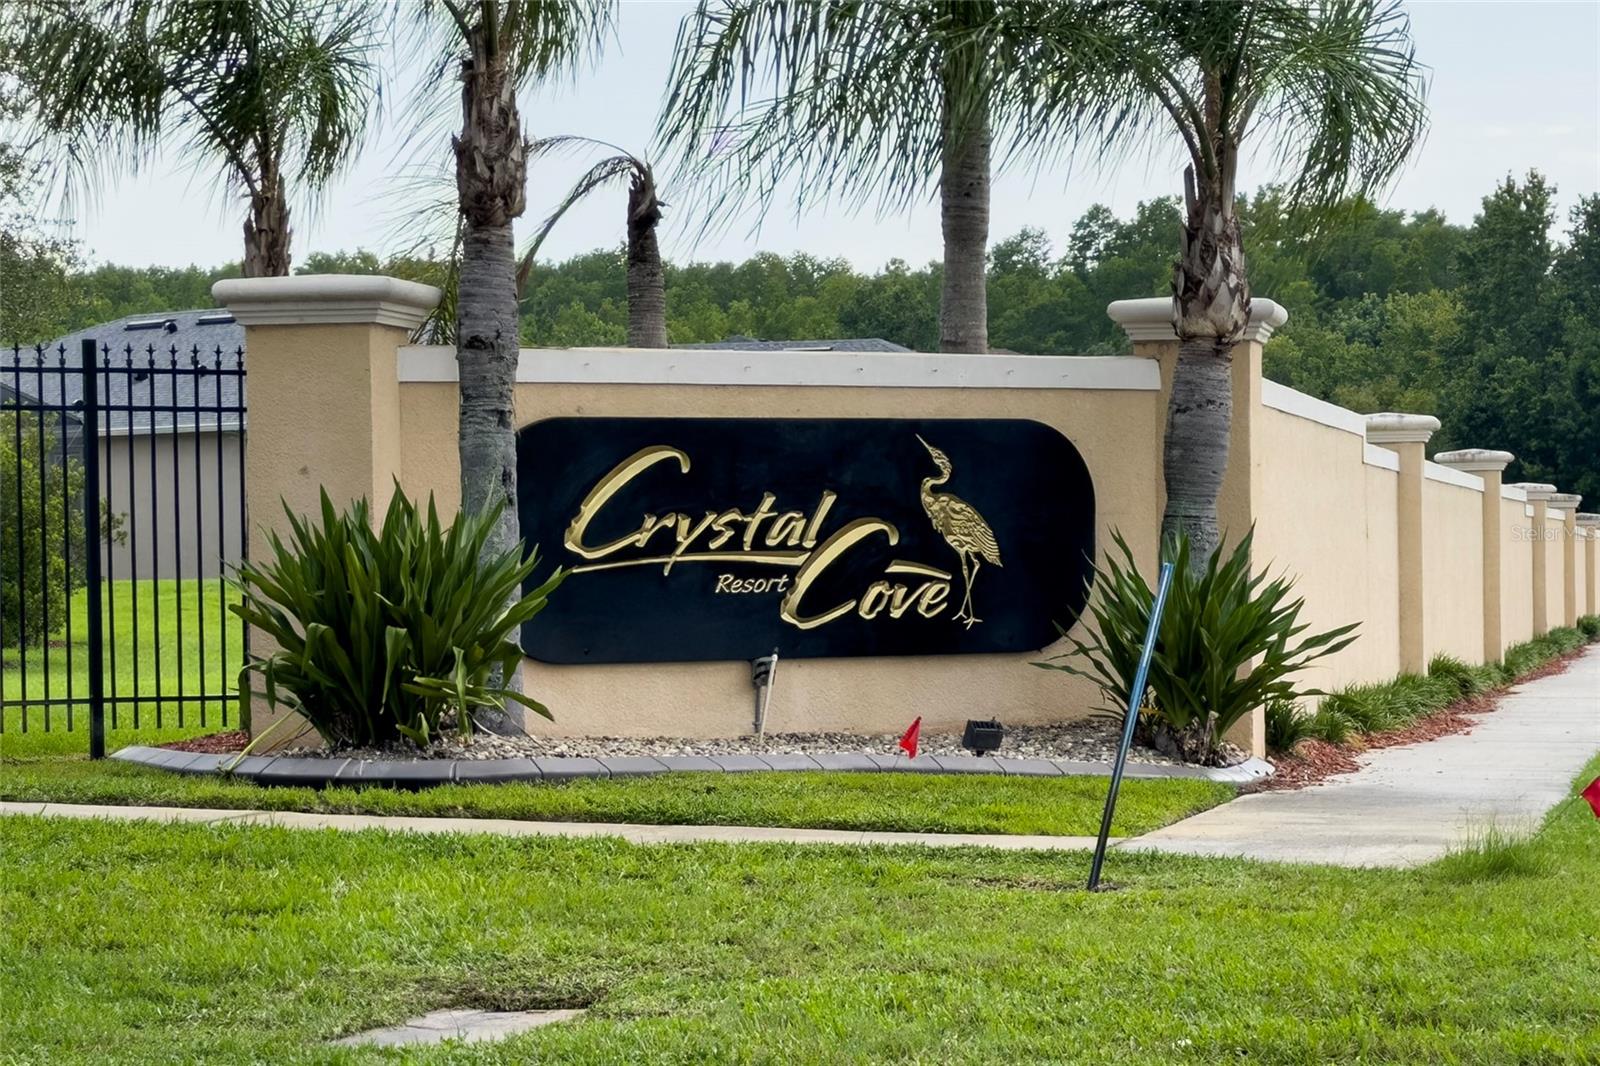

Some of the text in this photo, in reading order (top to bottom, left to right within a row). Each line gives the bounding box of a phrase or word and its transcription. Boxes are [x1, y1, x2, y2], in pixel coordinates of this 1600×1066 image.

[564, 445, 837, 576] Crystal
[715, 573, 789, 594] Resort
[780, 517, 952, 630] Cove
